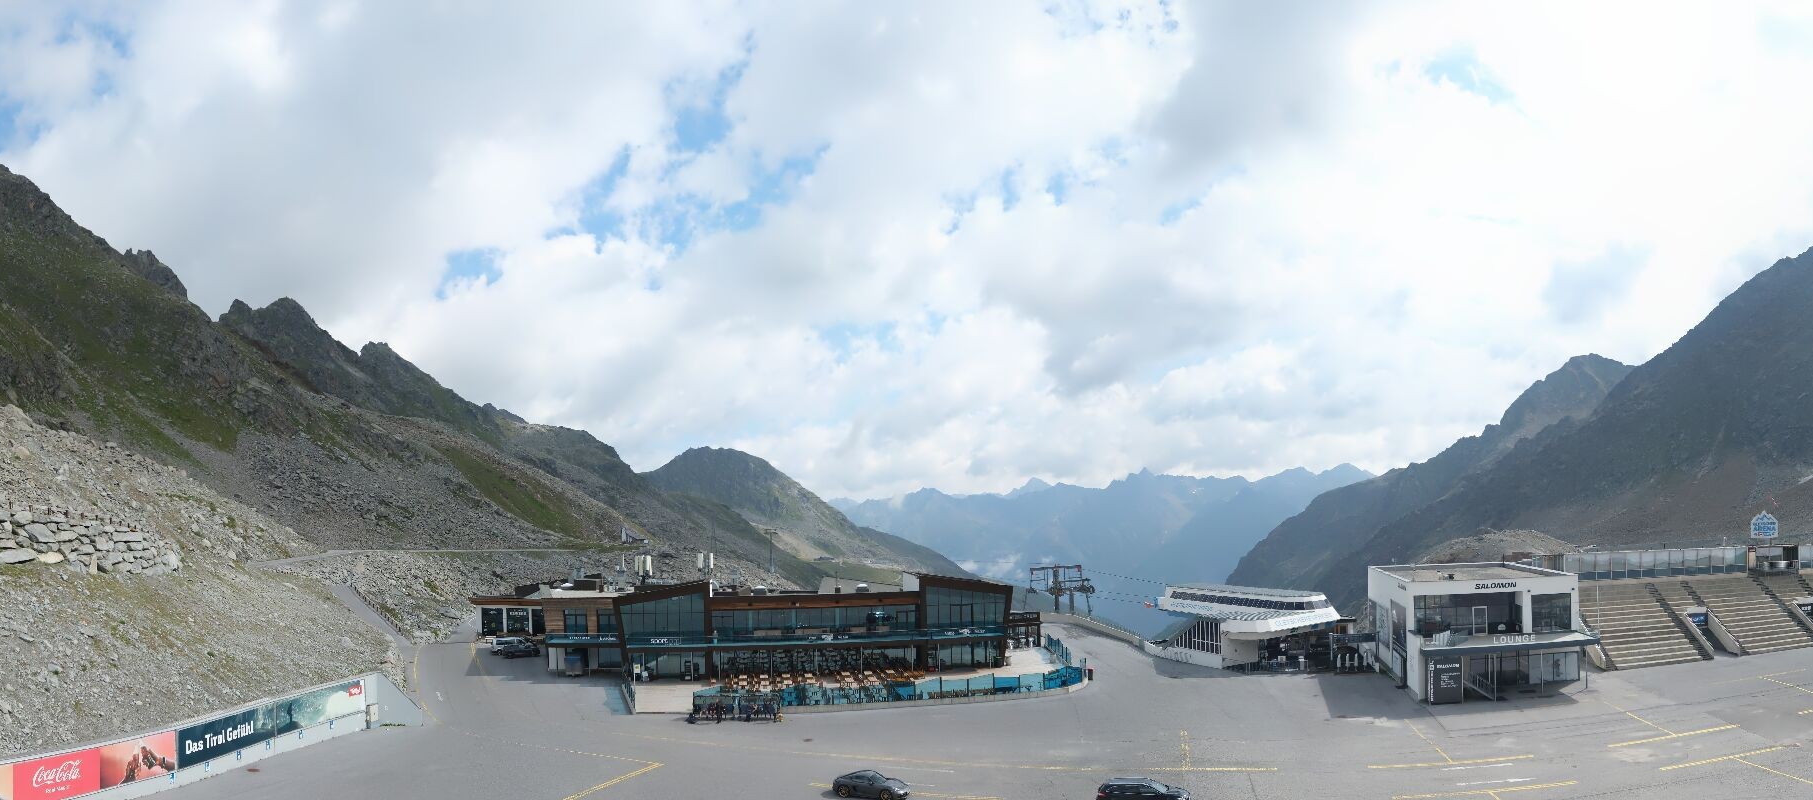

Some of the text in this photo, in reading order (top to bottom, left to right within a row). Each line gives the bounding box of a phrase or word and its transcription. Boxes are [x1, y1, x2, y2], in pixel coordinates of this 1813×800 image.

[1475, 581, 1517, 590] SALOMON
[1493, 634, 1536, 644] LOUNGE
[185, 720, 254, 755] Das Tirol Gefühl
